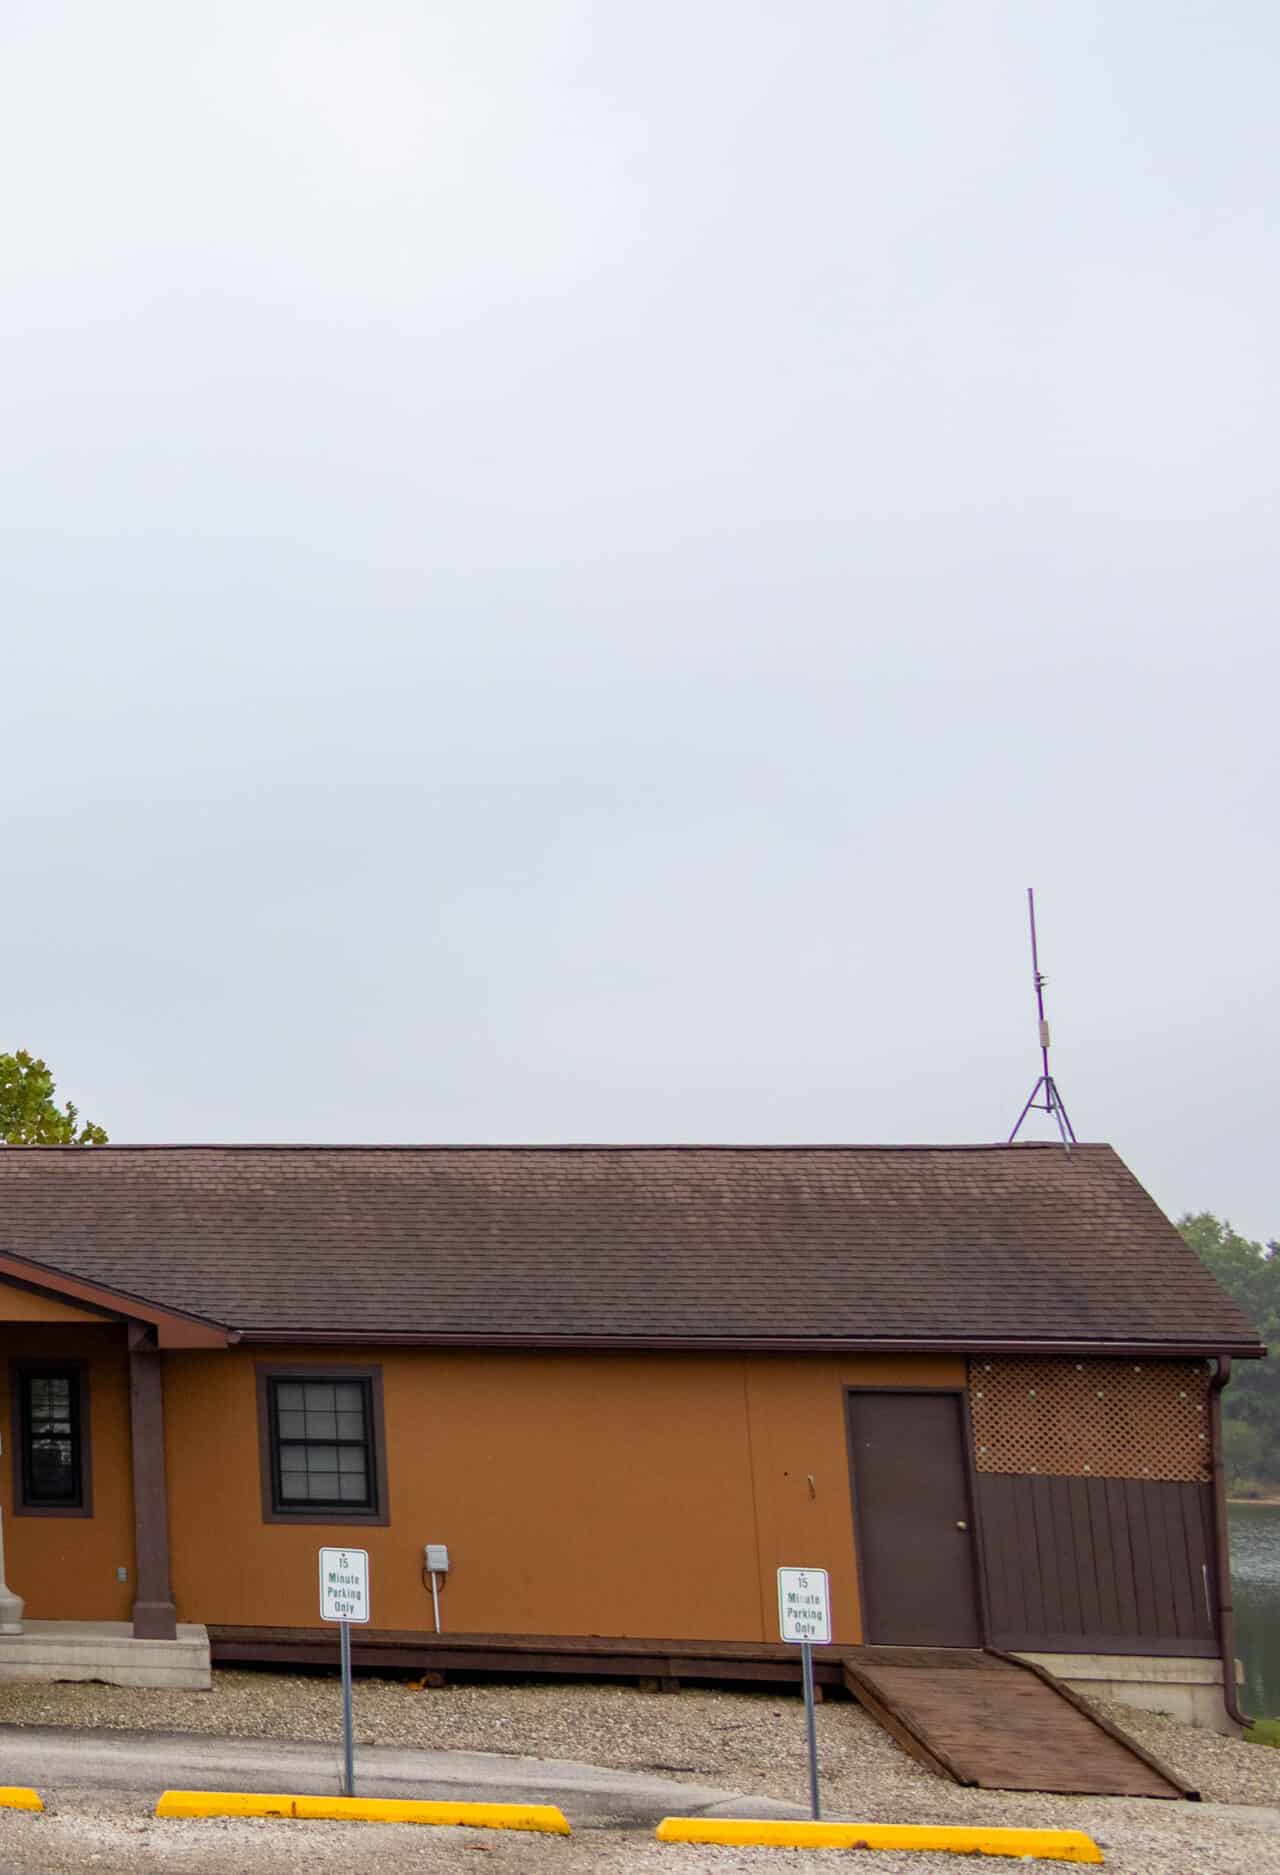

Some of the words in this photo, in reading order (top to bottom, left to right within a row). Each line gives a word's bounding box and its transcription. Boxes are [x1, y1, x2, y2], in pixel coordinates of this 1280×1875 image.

[338, 1557, 349, 1569] 15
[328, 1572, 360, 1585] Minute
[798, 1576, 809, 1589] 15
[327, 1586, 361, 1601] Parking
[787, 1592, 820, 1605] Miute
[334, 1601, 355, 1615] Only
[787, 1607, 822, 1621] Parking
[794, 1621, 816, 1635] Only
